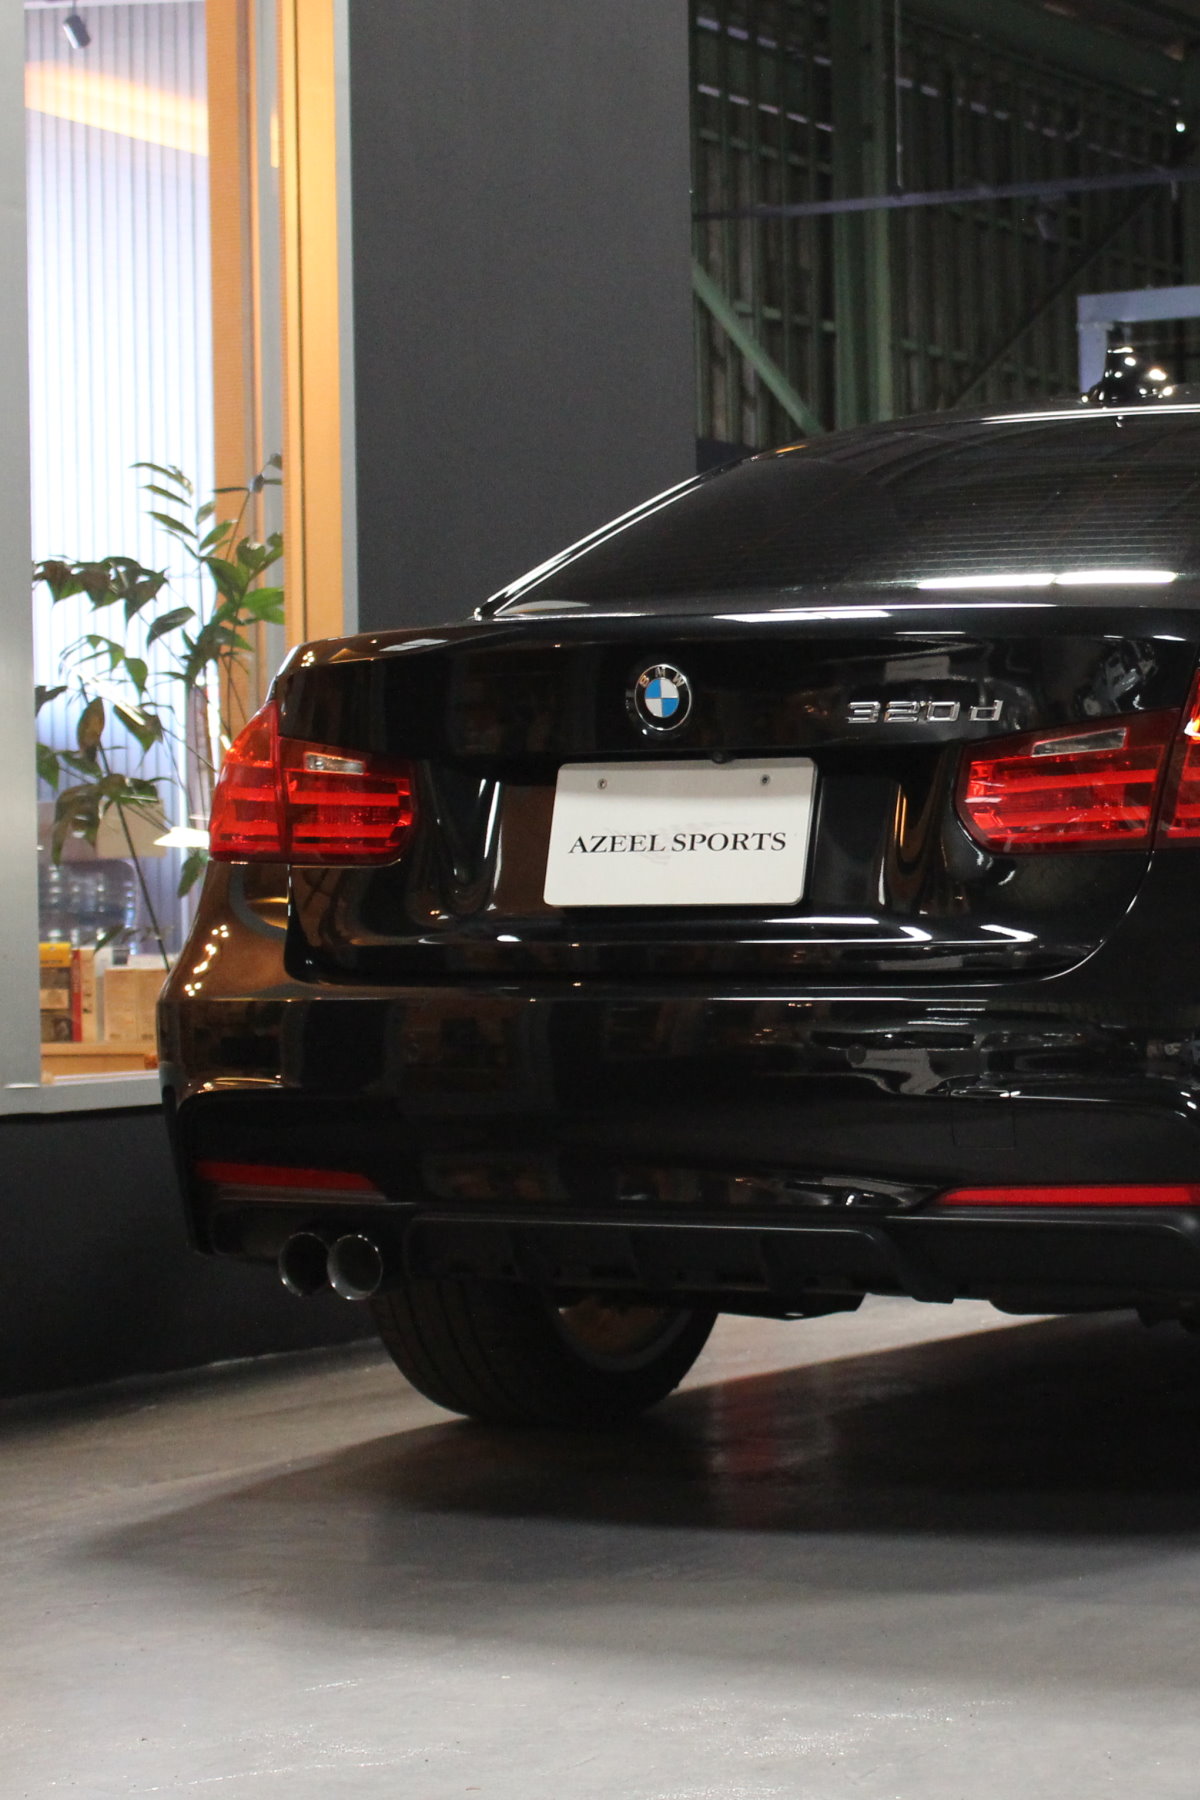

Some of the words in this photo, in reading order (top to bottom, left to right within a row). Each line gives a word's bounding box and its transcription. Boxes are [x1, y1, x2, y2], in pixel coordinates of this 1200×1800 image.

[638, 666, 685, 688] BMW
[568, 834, 665, 853] AZEEL
[671, 832, 786, 851] SPORTS
